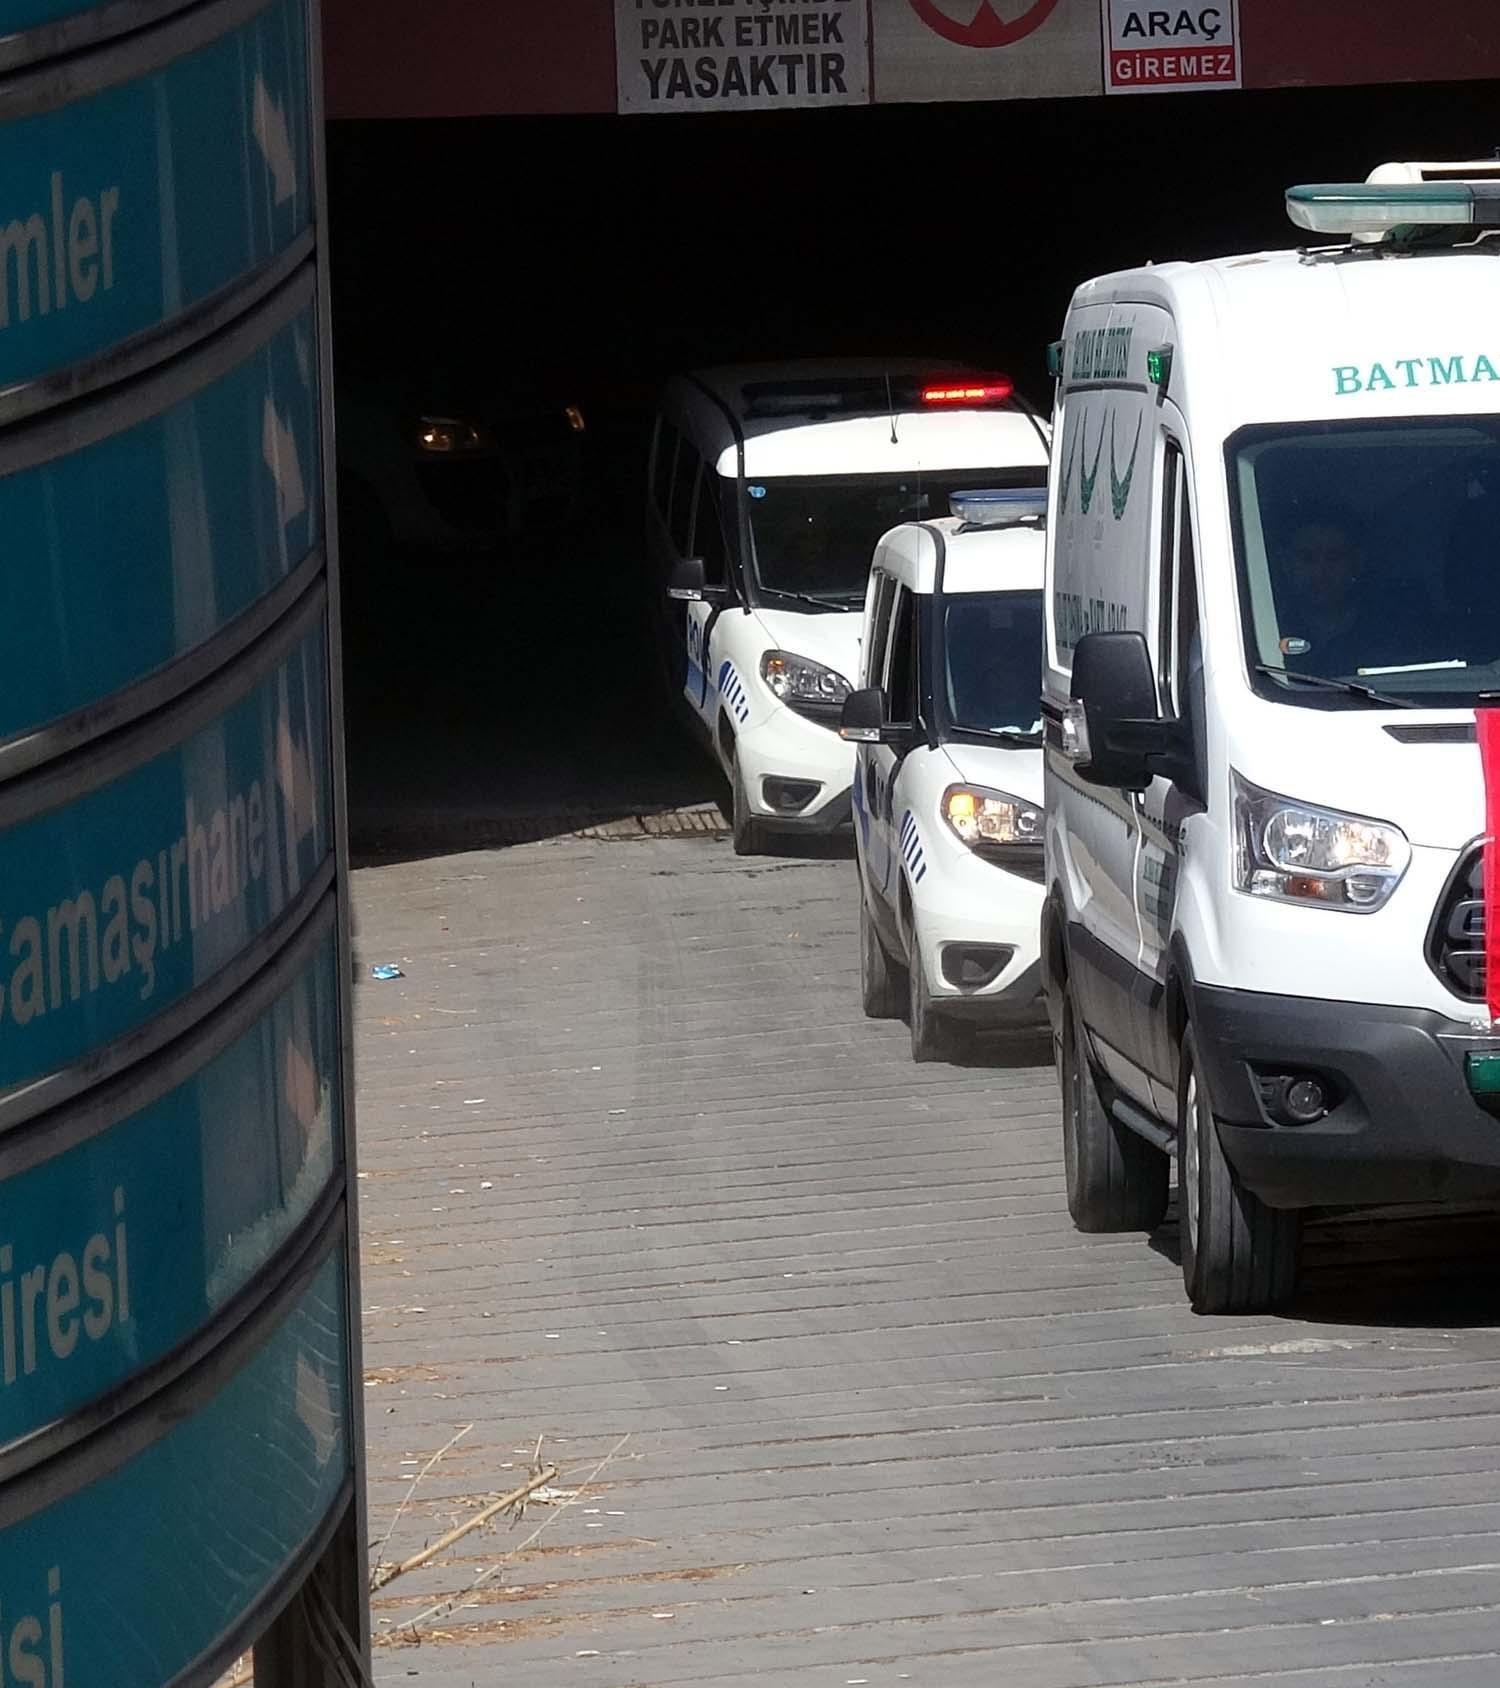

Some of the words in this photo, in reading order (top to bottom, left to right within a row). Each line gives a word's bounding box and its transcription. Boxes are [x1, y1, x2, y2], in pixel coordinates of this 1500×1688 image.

[641, 16, 724, 49] PARK
[735, 12, 843, 46] ETMEK
[1121, 8, 1221, 41] ARAÇ
[641, 52, 848, 100] YASAKTIR
[1115, 53, 1232, 80] GİREMEZ
[0, 779, 264, 1025] amaşırhane
[0, 1566, 65, 1688] si
